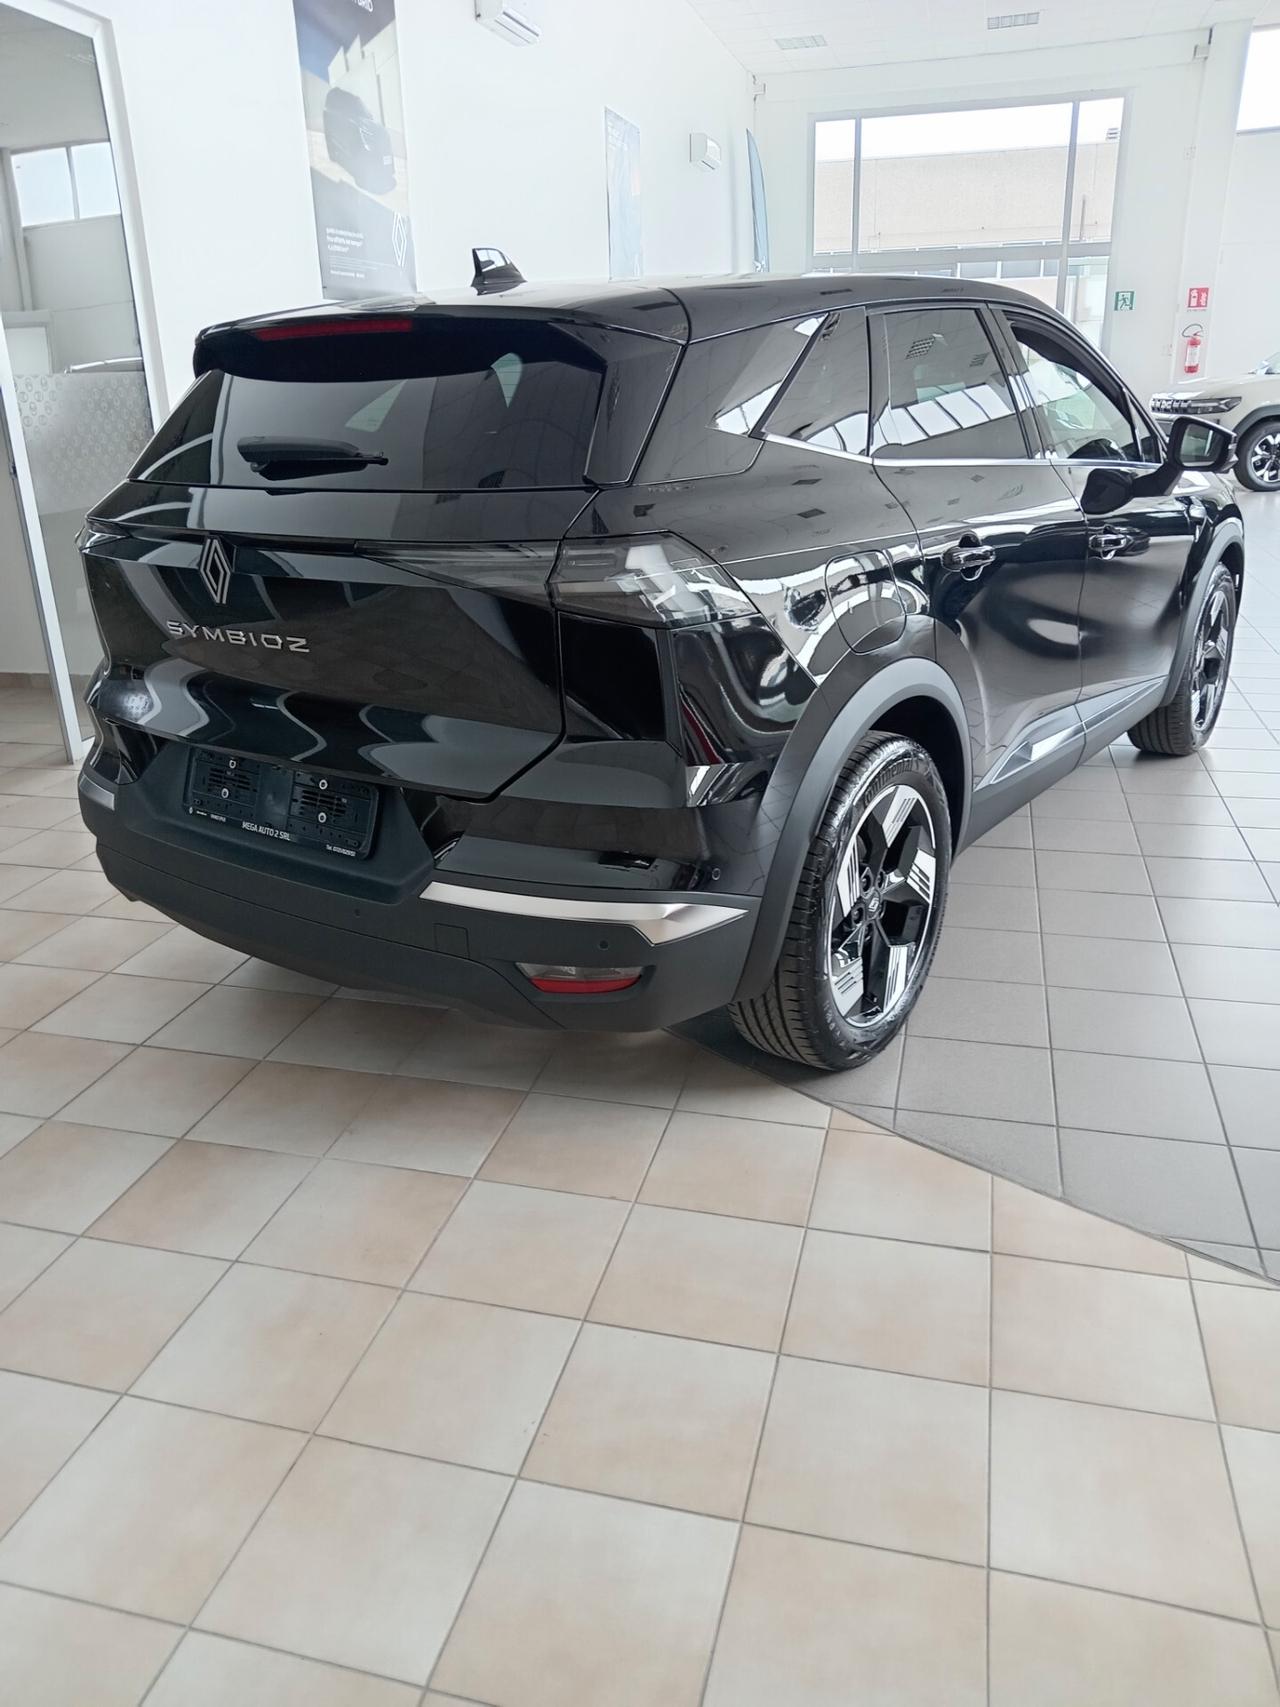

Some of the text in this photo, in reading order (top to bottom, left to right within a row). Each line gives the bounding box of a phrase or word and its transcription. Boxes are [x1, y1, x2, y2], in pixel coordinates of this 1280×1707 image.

[166, 619, 310, 653] SYMBIOZ
[242, 820, 291, 841] MEGA AUTO 2 SRL
